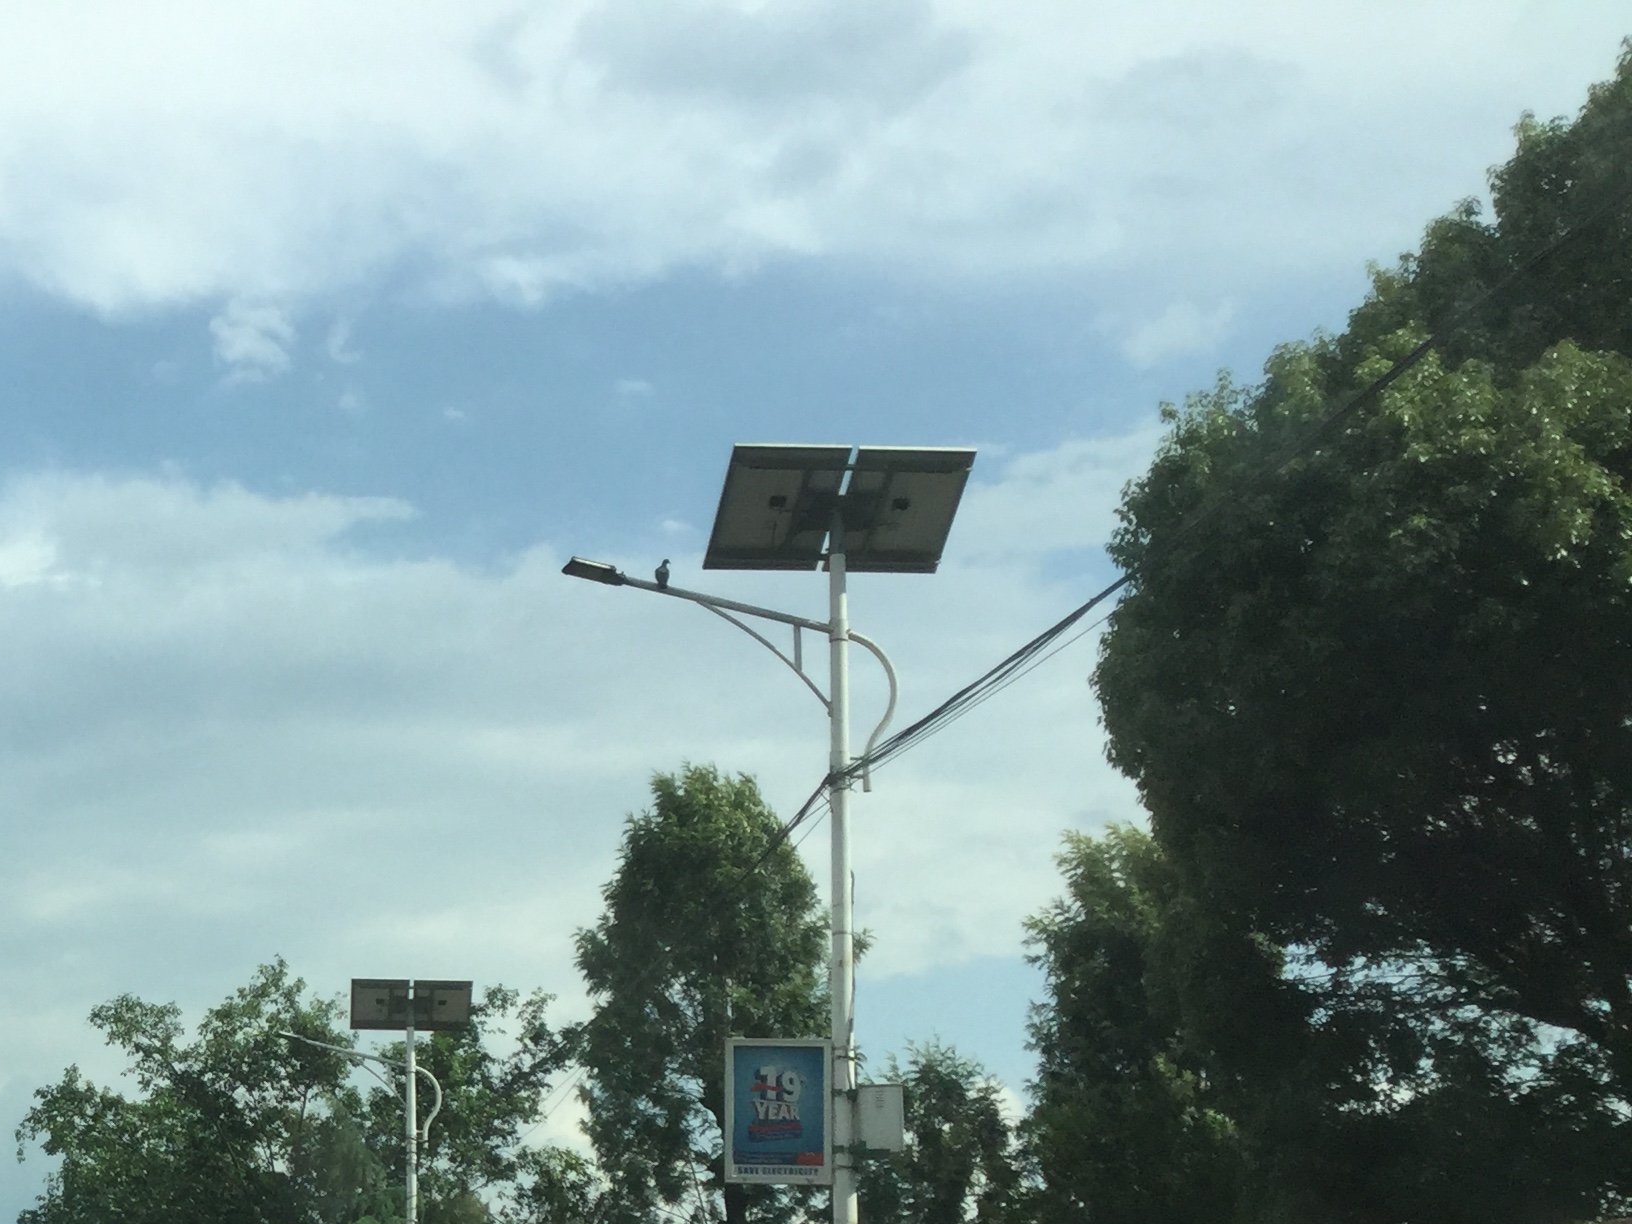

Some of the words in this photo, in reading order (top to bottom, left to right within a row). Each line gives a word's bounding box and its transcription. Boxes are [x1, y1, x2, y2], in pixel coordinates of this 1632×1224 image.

[751, 1099, 801, 1120] YEAR
[737, 1166, 759, 1175] SAVE
[762, 1166, 819, 1176] ELECTRICITY
